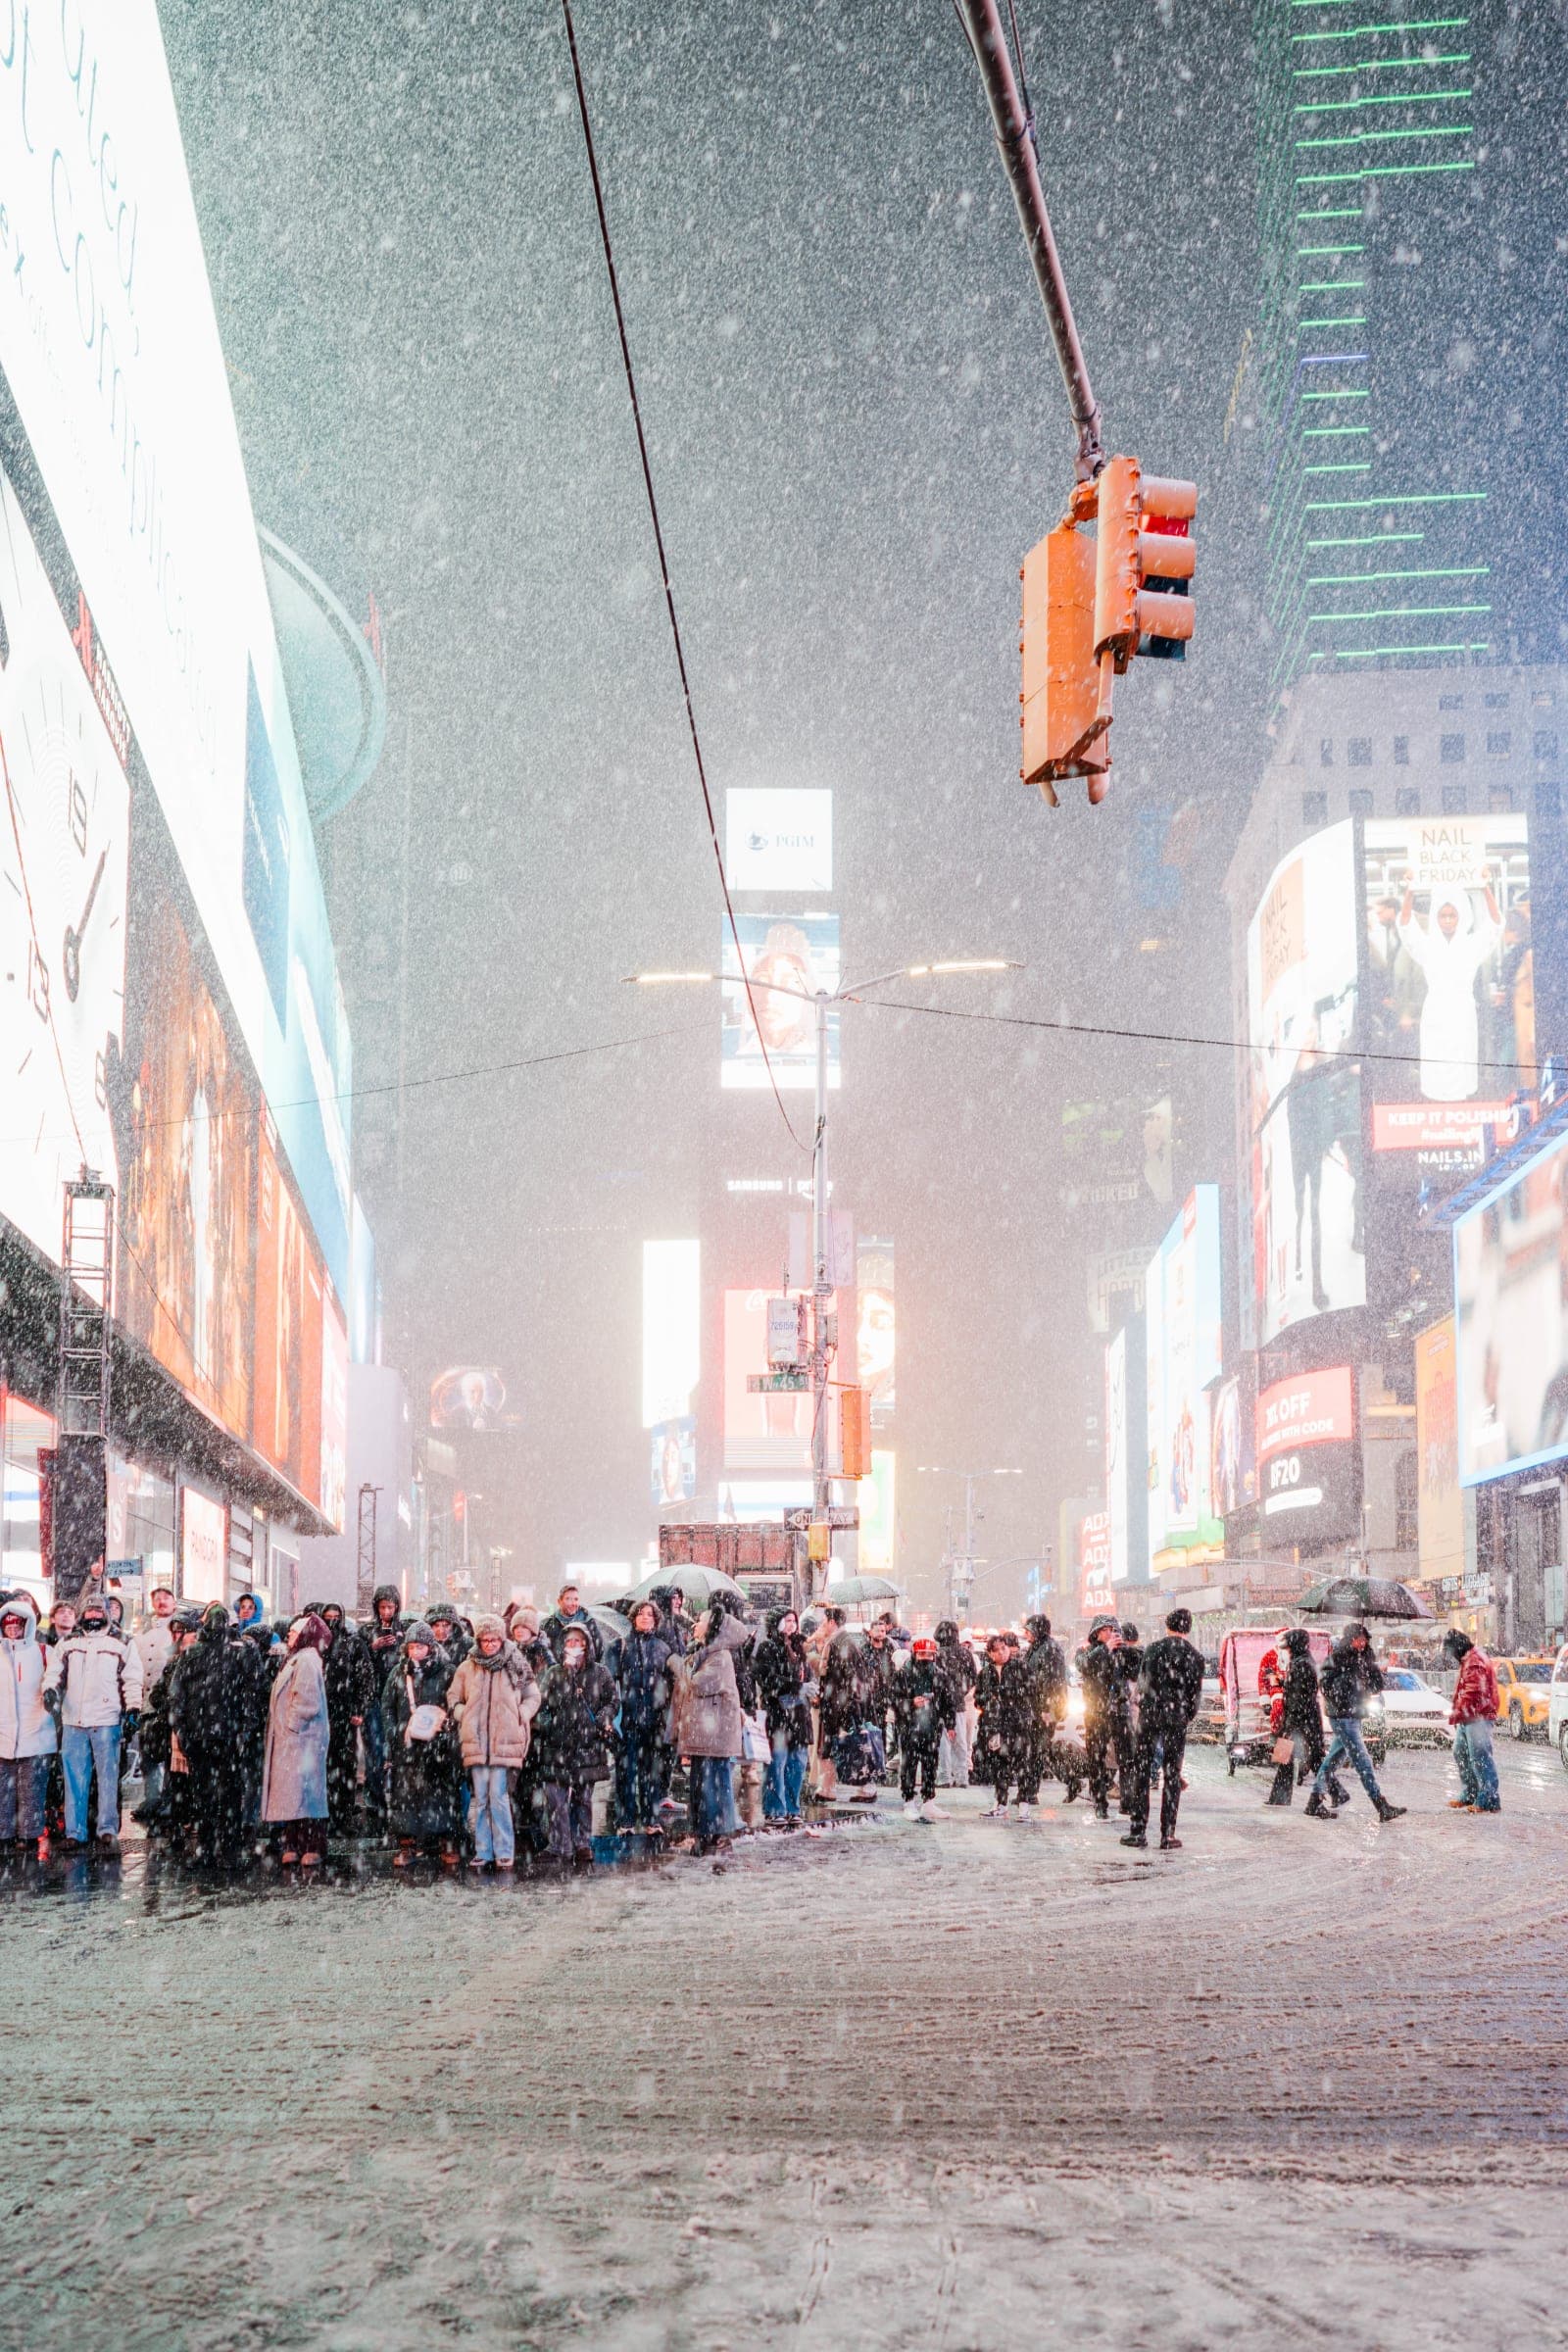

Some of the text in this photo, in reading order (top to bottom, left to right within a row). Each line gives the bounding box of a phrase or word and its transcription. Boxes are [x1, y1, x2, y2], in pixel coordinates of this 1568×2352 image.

[775, 834, 815, 848] PGIM
[1422, 827, 1472, 847] NAIL
[1420, 851, 1471, 863] BLACK
[1419, 868, 1477, 883] FRIDAY
[1388, 1112, 1428, 1125] KEEP
[1429, 1111, 1444, 1124] IT
[1418, 1151, 1484, 1164] NAILS.IN
[780, 1375, 794, 1390] 45
[1279, 1392, 1311, 1421] OFF
[1301, 1418, 1334, 1435] CODE
